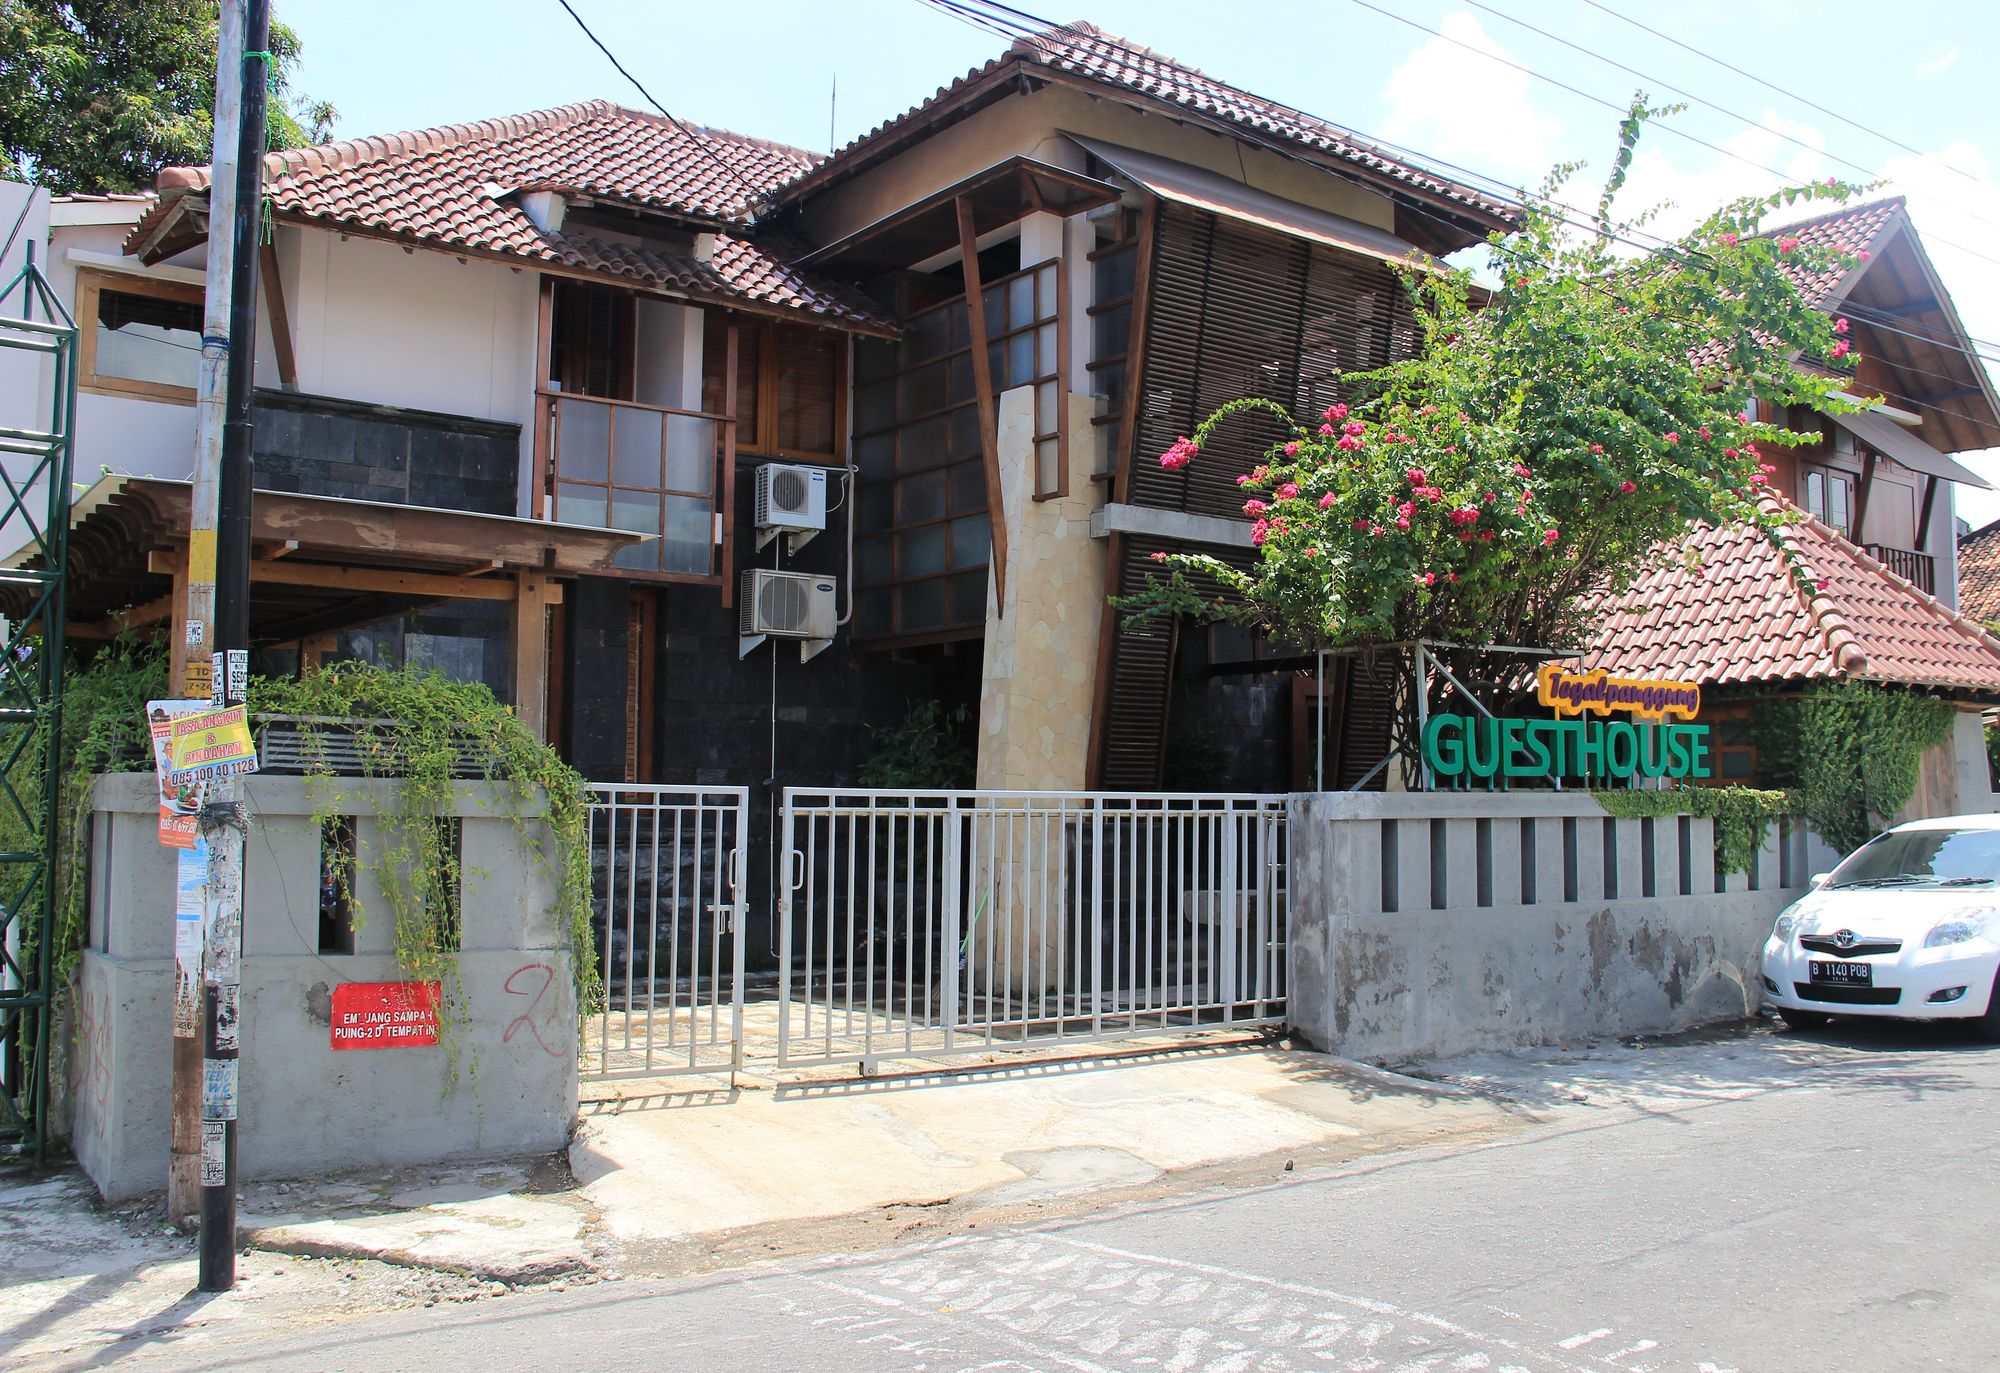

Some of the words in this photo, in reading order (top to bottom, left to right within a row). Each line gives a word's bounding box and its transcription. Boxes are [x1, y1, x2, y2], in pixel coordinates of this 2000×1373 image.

[175, 720, 201, 736] JASA
[201, 709, 243, 729] ANGKUT
[205, 732, 216, 744] &
[1421, 713, 1711, 778] GUESTHOUSE
[184, 741, 243, 765] PINDAHAN
[172, 771, 192, 785] 085
[195, 766, 213, 781] 100
[216, 764, 229, 777] 40
[232, 759, 254, 774] 1128
[1812, 963, 1819, 975] B
[1826, 963, 1847, 976] 1140
[1850, 964, 1868, 977] POB
[335, 1027, 373, 1039] PUING-2
[386, 1024, 424, 1038] TEMPAT
